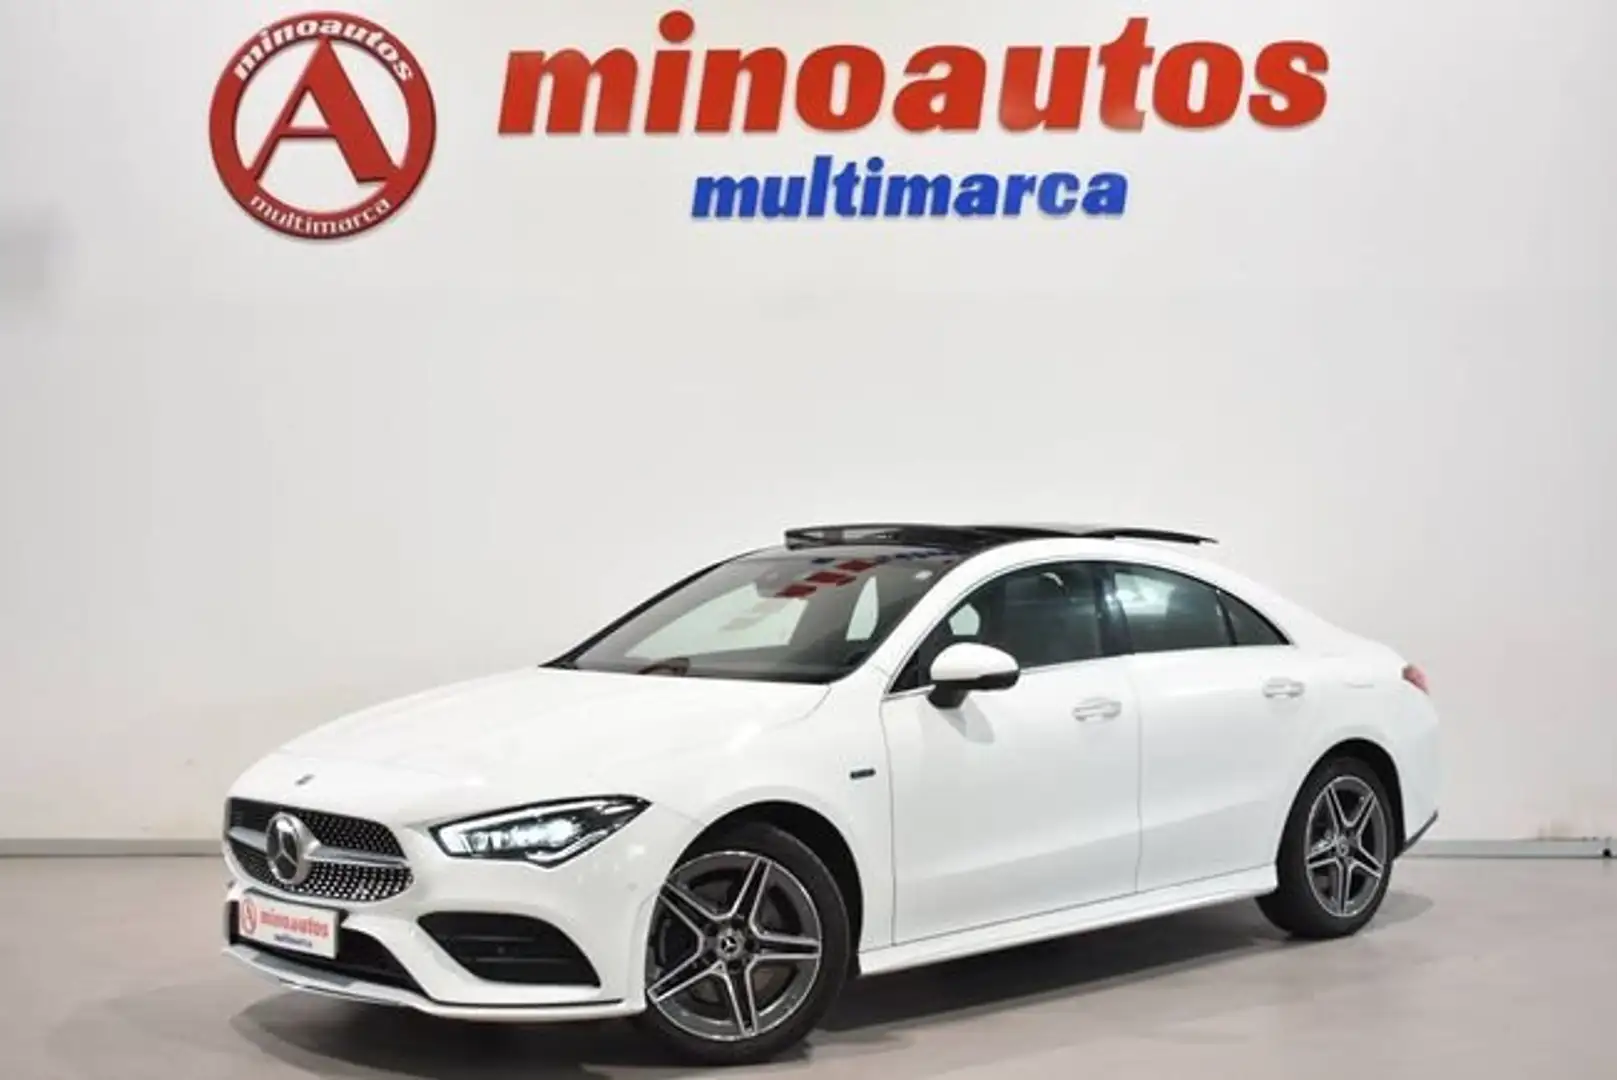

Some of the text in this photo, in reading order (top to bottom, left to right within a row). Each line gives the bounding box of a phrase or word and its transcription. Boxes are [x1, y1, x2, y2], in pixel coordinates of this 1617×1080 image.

[234, 19, 413, 81] minoautos
[498, 11, 1329, 134] minoautos
[253, 37, 397, 183] A
[251, 197, 391, 234] multimarca
[691, 155, 1128, 218] multimarca
